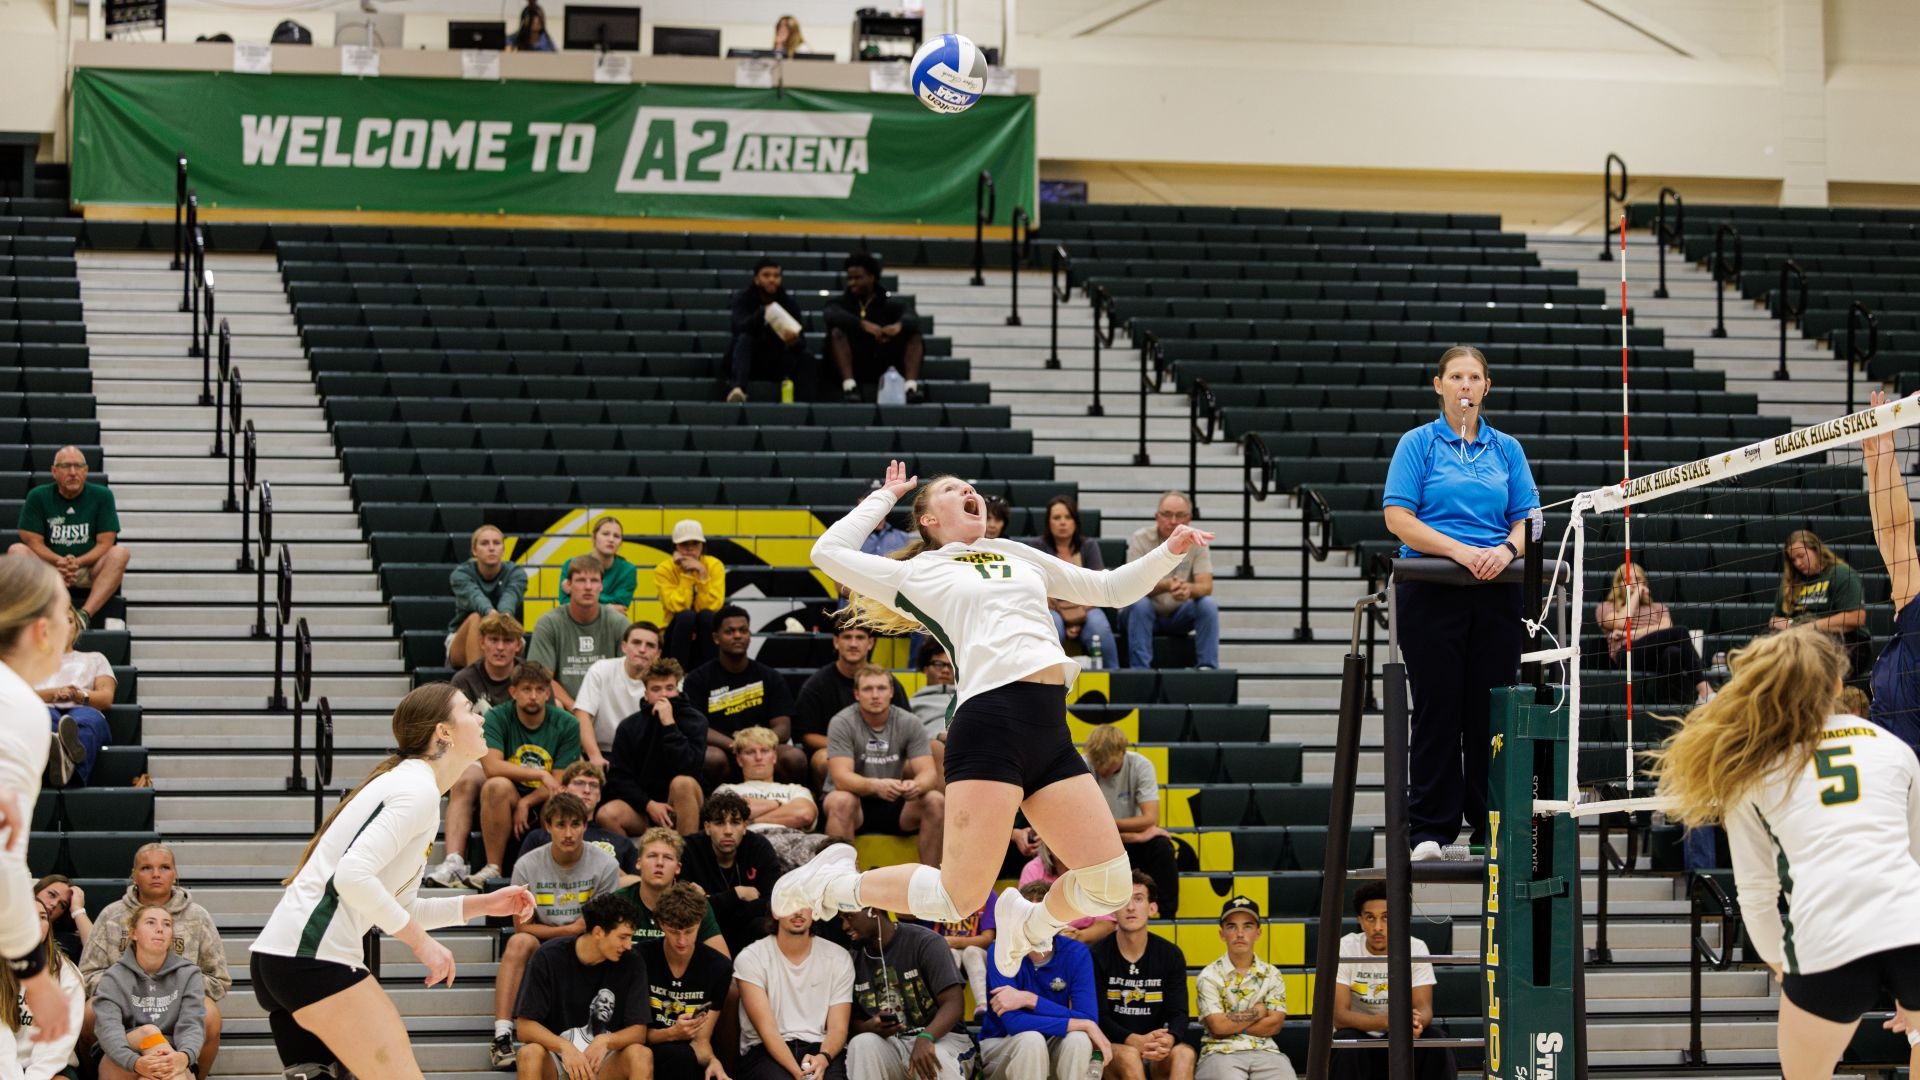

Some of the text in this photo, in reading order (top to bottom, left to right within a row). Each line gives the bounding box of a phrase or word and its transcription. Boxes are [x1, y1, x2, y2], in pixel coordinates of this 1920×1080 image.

[927, 93, 967, 112] molten
[936, 85, 971, 105] NCAA
[241, 114, 597, 173] WELCOME TO
[631, 117, 869, 183] A2 ARENA
[1774, 428, 1808, 456] BLACK
[1810, 418, 1842, 445] HILLS
[1843, 409, 1878, 436] STATE
[1622, 458, 1711, 499] BLACK HILLS STATE
[51, 523, 90, 539] BHSU
[975, 563, 1013, 579] 17
[724, 696, 764, 716] JACKETS
[1812, 744, 1860, 808] 5
[1486, 811, 1502, 1080] YELLO
[1125, 979, 1144, 987] HILLS
[684, 991, 705, 1000] STATE
